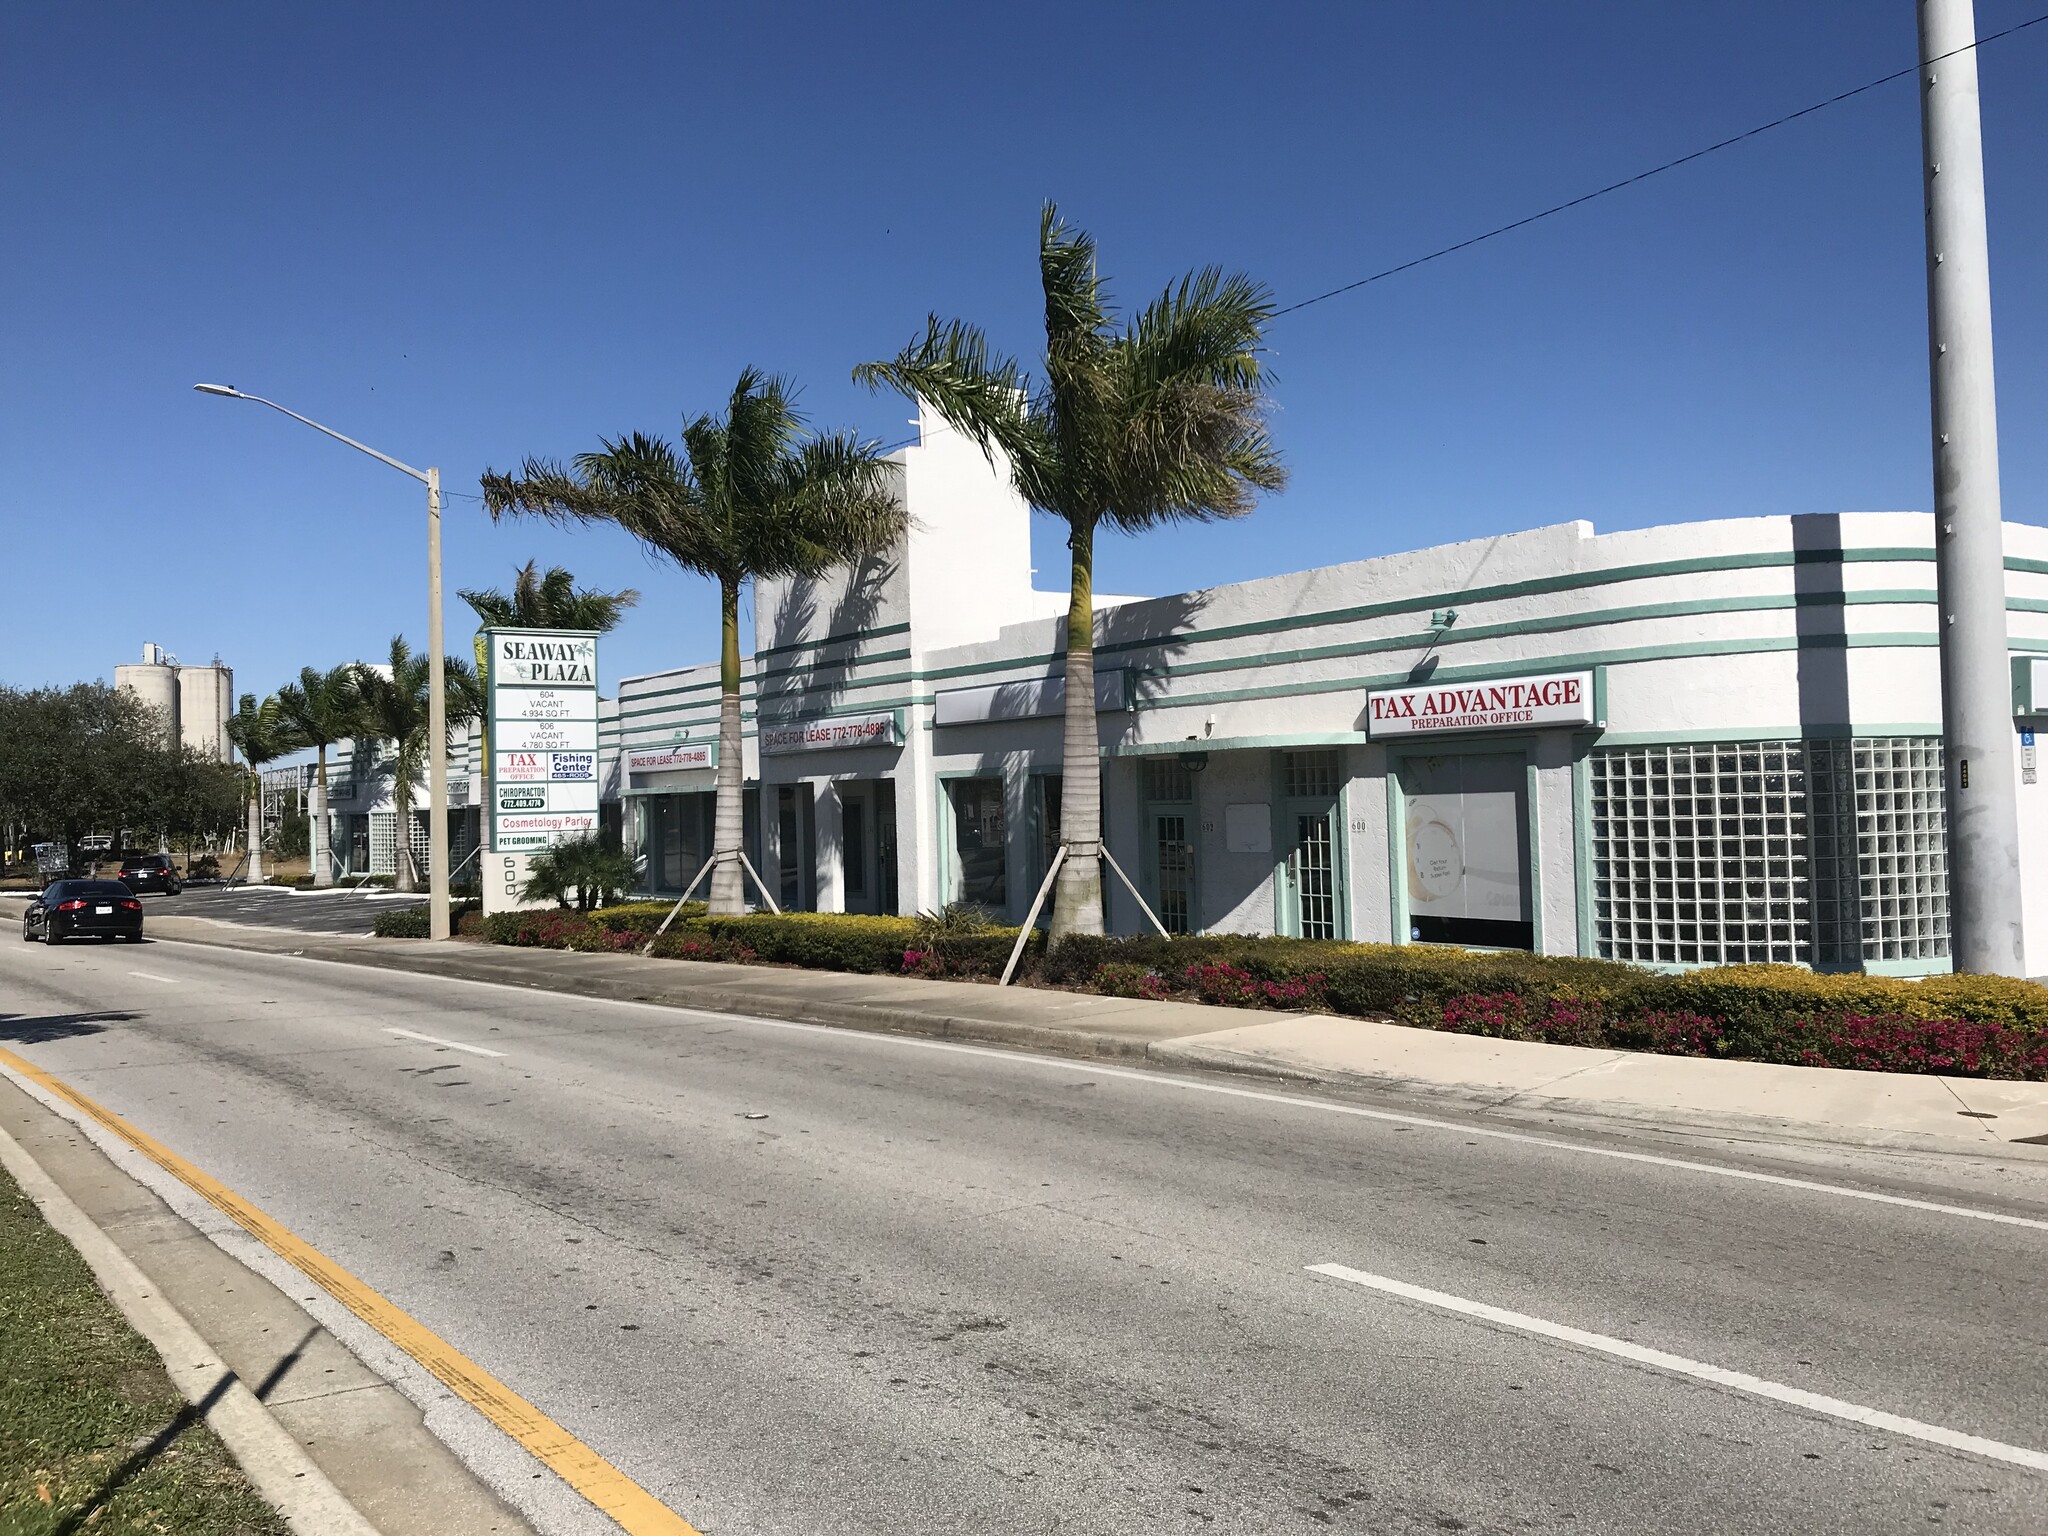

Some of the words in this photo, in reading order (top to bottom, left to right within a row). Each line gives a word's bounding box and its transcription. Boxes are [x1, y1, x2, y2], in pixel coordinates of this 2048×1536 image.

[503, 641, 578, 661] SEAWAY
[531, 663, 592, 682] PLAZA
[539, 691, 554, 699] 604
[1371, 695, 1416, 720] TAX
[1422, 679, 1581, 717] ADVANTAGE
[529, 700, 564, 708] VACANT
[1411, 713, 1488, 730] PREPARATION
[1491, 710, 1533, 724] OFFICE
[539, 722, 554, 730] 606
[529, 732, 564, 740] VACANT
[764, 732, 788, 746] SPACE
[789, 731, 804, 744] FOR
[805, 728, 830, 742] LEASE
[833, 722, 885, 740] 772-778-4885
[508, 753, 536, 766] TAX
[552, 753, 592, 764] Fishing
[631, 756, 646, 767] SPACE
[647, 756, 657, 766] FOR
[657, 754, 673, 765] LEASE
[498, 766, 545, 774] PREPARATION
[554, 763, 591, 772] Center
[499, 787, 546, 798] CHIROPRACTOR
[502, 817, 562, 830] Cosmetology
[565, 816, 593, 827] Parlor
[1351, 821, 1366, 831] 600
[499, 837, 511, 846] PET
[512, 836, 547, 845] GROOMING
[503, 856, 516, 896] 600
